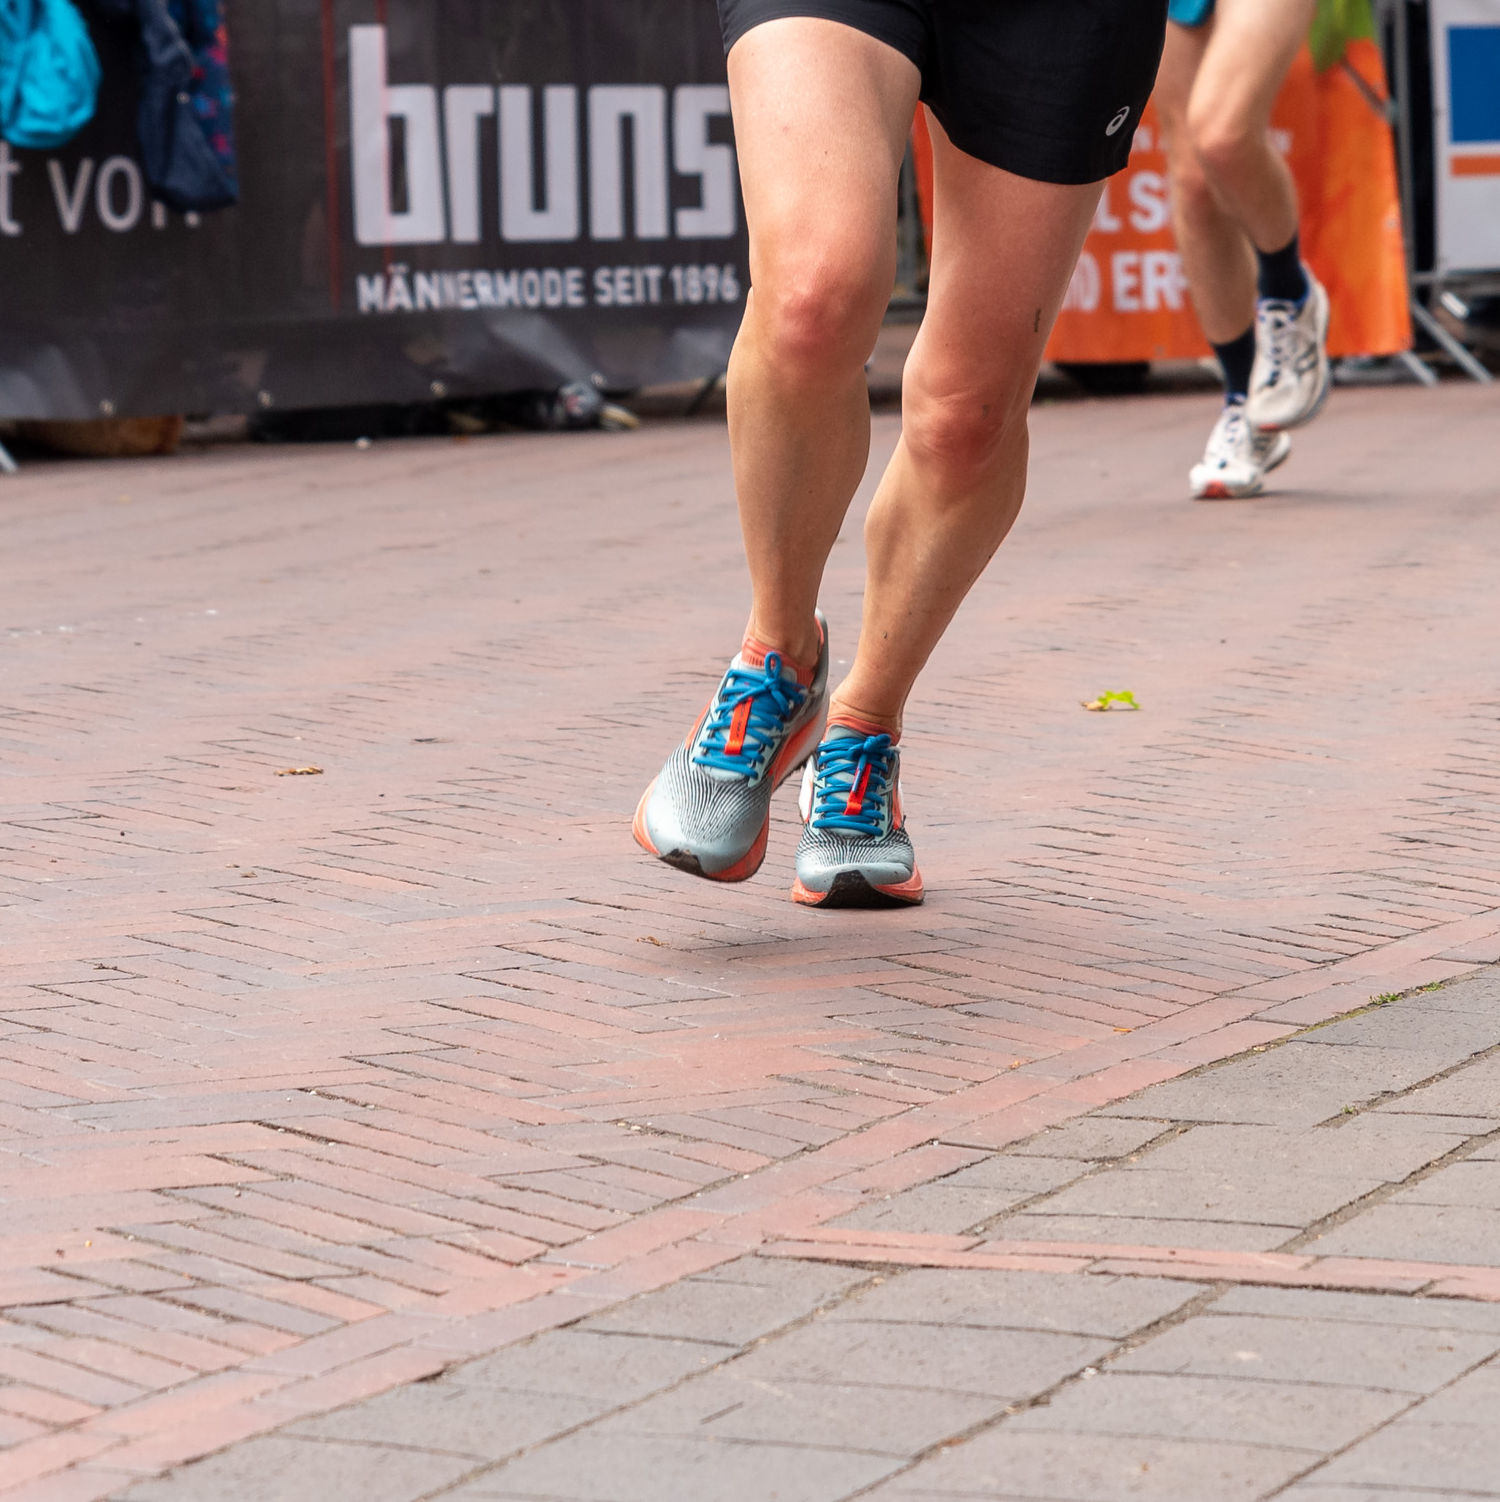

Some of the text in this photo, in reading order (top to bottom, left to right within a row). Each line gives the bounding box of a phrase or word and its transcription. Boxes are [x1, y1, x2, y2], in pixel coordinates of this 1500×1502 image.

[348, 24, 737, 246] bruns
[593, 265, 665, 306] SEIT
[669, 263, 741, 303] 1896
